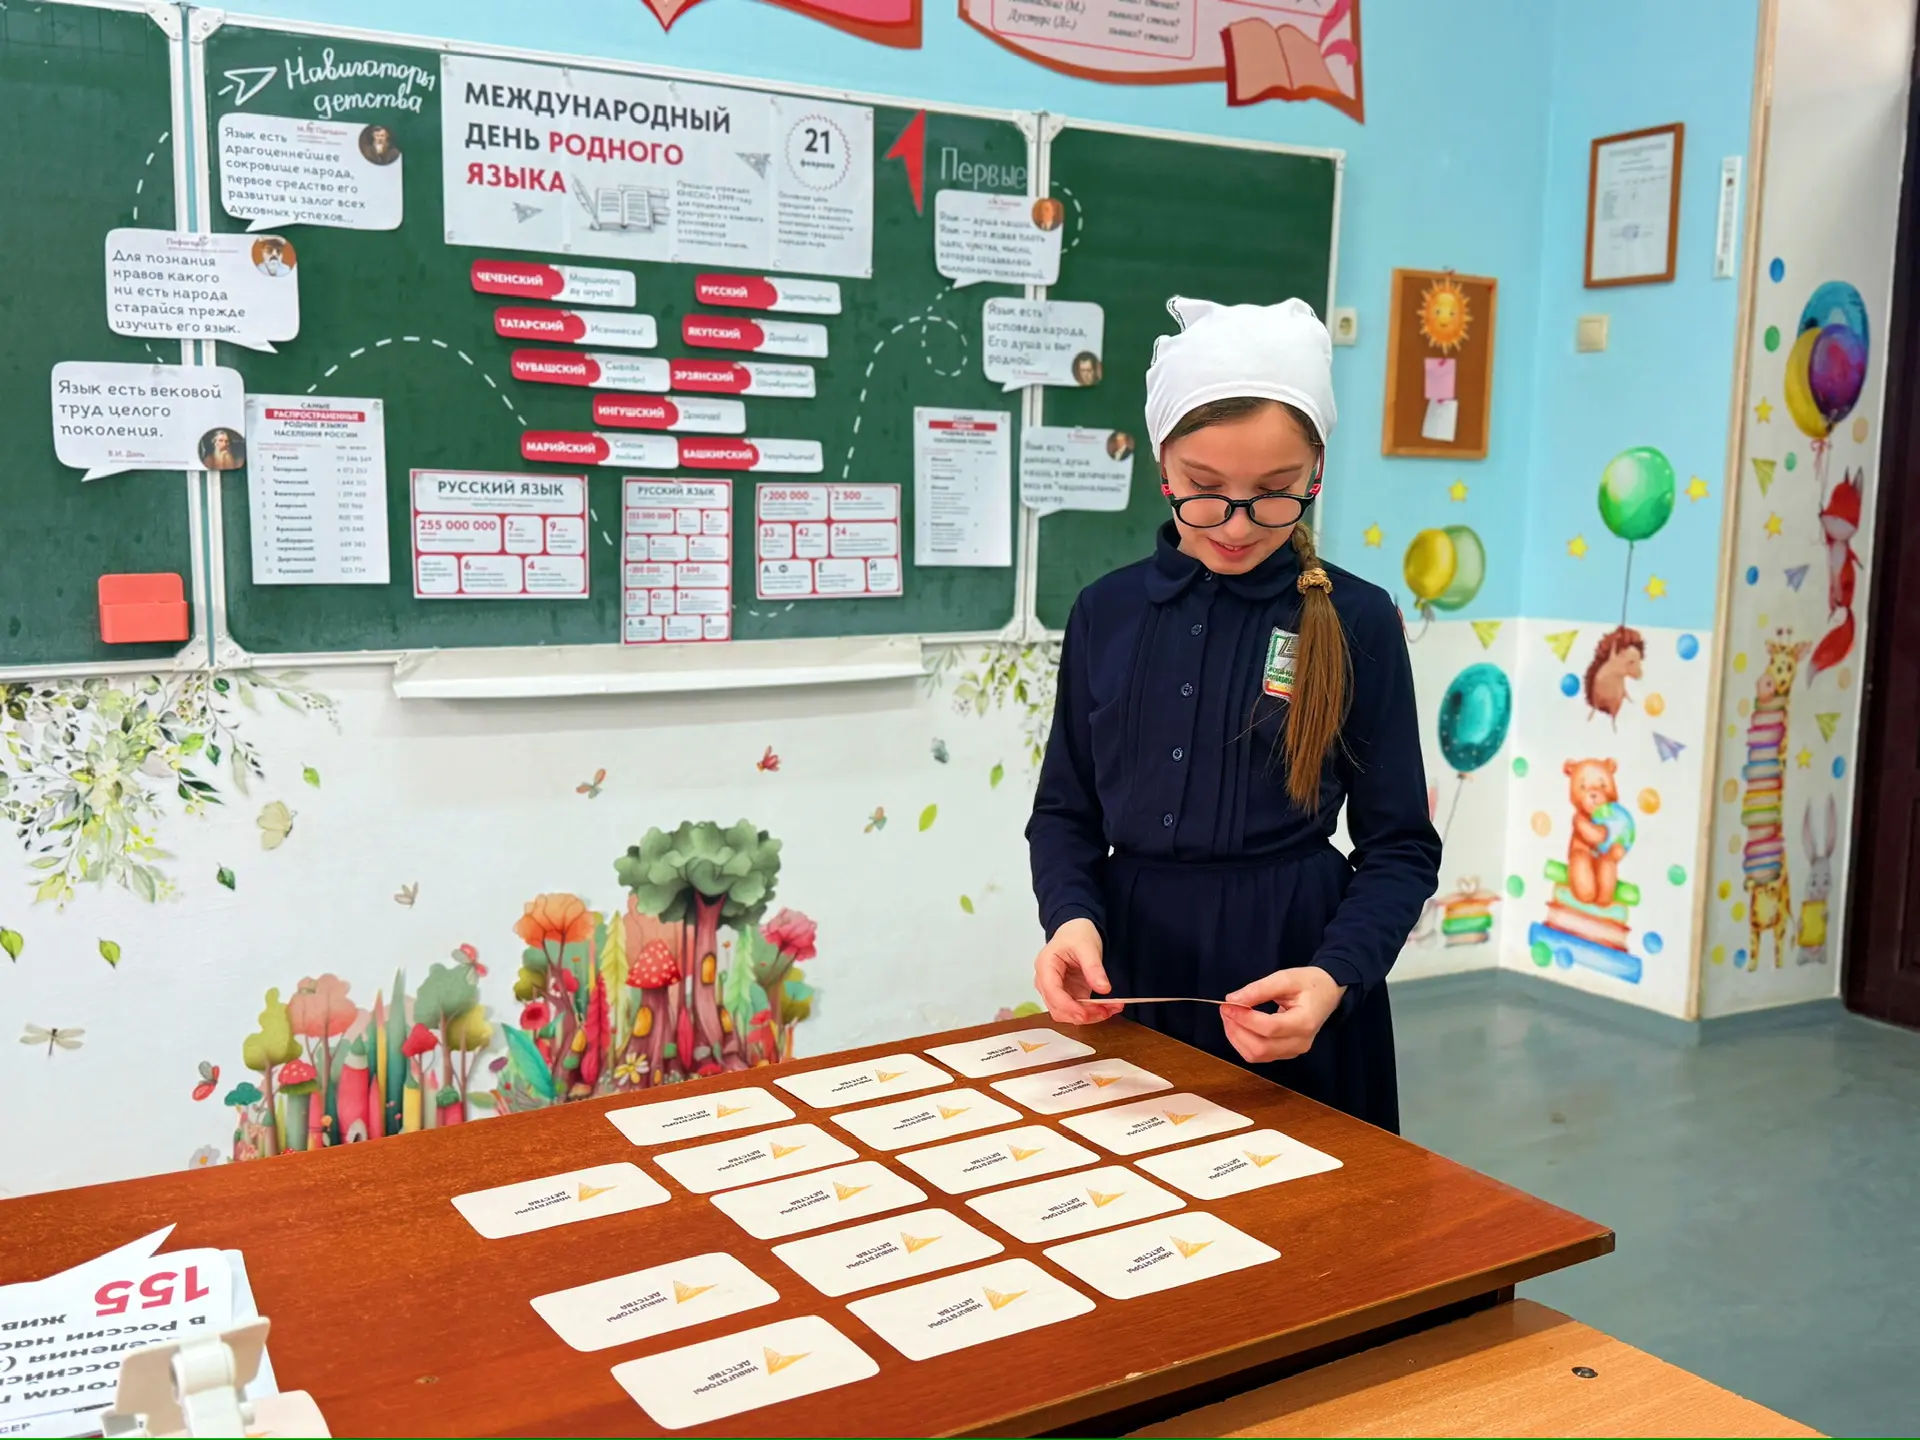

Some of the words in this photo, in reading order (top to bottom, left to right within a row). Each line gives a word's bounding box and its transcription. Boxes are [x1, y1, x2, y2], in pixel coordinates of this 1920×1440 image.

[285, 47, 435, 95] Навигаторы
[313, 84, 423, 119] детства
[465, 82, 731, 134] МЕЖДУНАРОДНЫЙ
[224, 127, 256, 140] Язык
[259, 133, 288, 143] есть
[804, 128, 831, 154] 21
[465, 123, 540, 151] ДЕНЬ
[549, 132, 684, 166] РОДНОГО
[225, 145, 340, 164] драгоценнейшее
[226, 160, 300, 174] сокровище
[303, 168, 355, 181] народа,
[941, 147, 1028, 190] Первые
[227, 175, 272, 188] первое
[275, 180, 334, 193] средство
[337, 184, 359, 194] его
[467, 162, 567, 193] ЯЗЫКА
[228, 190, 286, 204] развития
[289, 195, 298, 203] и
[301, 197, 334, 207] залог
[337, 199, 366, 209] всех
[229, 205, 290, 218] духовных
[112, 250, 142, 262] Для
[146, 254, 216, 267] познания
[113, 269, 164, 281] нравов
[168, 272, 220, 284] какого
[477, 272, 543, 286] ЧЕЧЕНСКИЙ
[114, 285, 133, 295] ни
[137, 287, 169, 298] есть
[173, 290, 228, 302] народа
[701, 285, 748, 298] РУССКИЙ
[114, 302, 184, 316] старайся
[188, 307, 246, 319] прежде
[115, 320, 173, 332] изучить
[177, 323, 200, 332] его
[204, 324, 241, 334] язык.
[499, 318, 565, 332] ТАТАРСКИЙ
[688, 326, 741, 339] ЯКУТСКИЙ
[516, 361, 586, 375] ЧУВАШСКИЙ
[674, 369, 734, 382] ЭРЗЯНСКИЙ
[58, 379, 102, 395] Язык
[107, 385, 146, 397] есть
[150, 384, 222, 399] вековой
[59, 403, 104, 419] труд
[108, 405, 171, 418] целого
[300, 402, 331, 410] САМЫЕ
[598, 405, 665, 419] ИНГУШСКИЙ
[60, 424, 164, 439] поколения.
[284, 421, 318, 430] РОДНЫЕ
[526, 441, 595, 453] МАРИЙСКИЙ
[683, 447, 753, 460] БАШКИРСКИЙ
[438, 479, 515, 496] РУССКИЙ
[520, 482, 564, 496] ЯЗЫК
[637, 484, 684, 496] РУССКИЙ
[686, 487, 715, 497] ЯЗЫК
[789, 491, 810, 500] 000
[420, 520, 442, 531] 255
[446, 520, 469, 531] 000
[473, 520, 496, 531] 000
[549, 521, 556, 532] 9
[797, 527, 809, 538] 42
[835, 527, 847, 537] 24
[464, 561, 471, 570] 6
[528, 561, 535, 570] 4
[527, 1190, 566, 1206] ДЕТСТВА
[789, 1190, 824, 1206] ДЕТСТВА
[1048, 1197, 1080, 1212] ДЕТСТВА
[856, 1242, 892, 1258] ДЕТСТВА
[1133, 1246, 1166, 1264] ДЕТСТВА
[94, 1265, 210, 1318] 155
[620, 1291, 661, 1310] ДЕТСТВА
[937, 1298, 975, 1316] ДЕТСТВА
[66, 1320, 178, 1342] России
[707, 1359, 751, 1381] ДЕТСТВА
